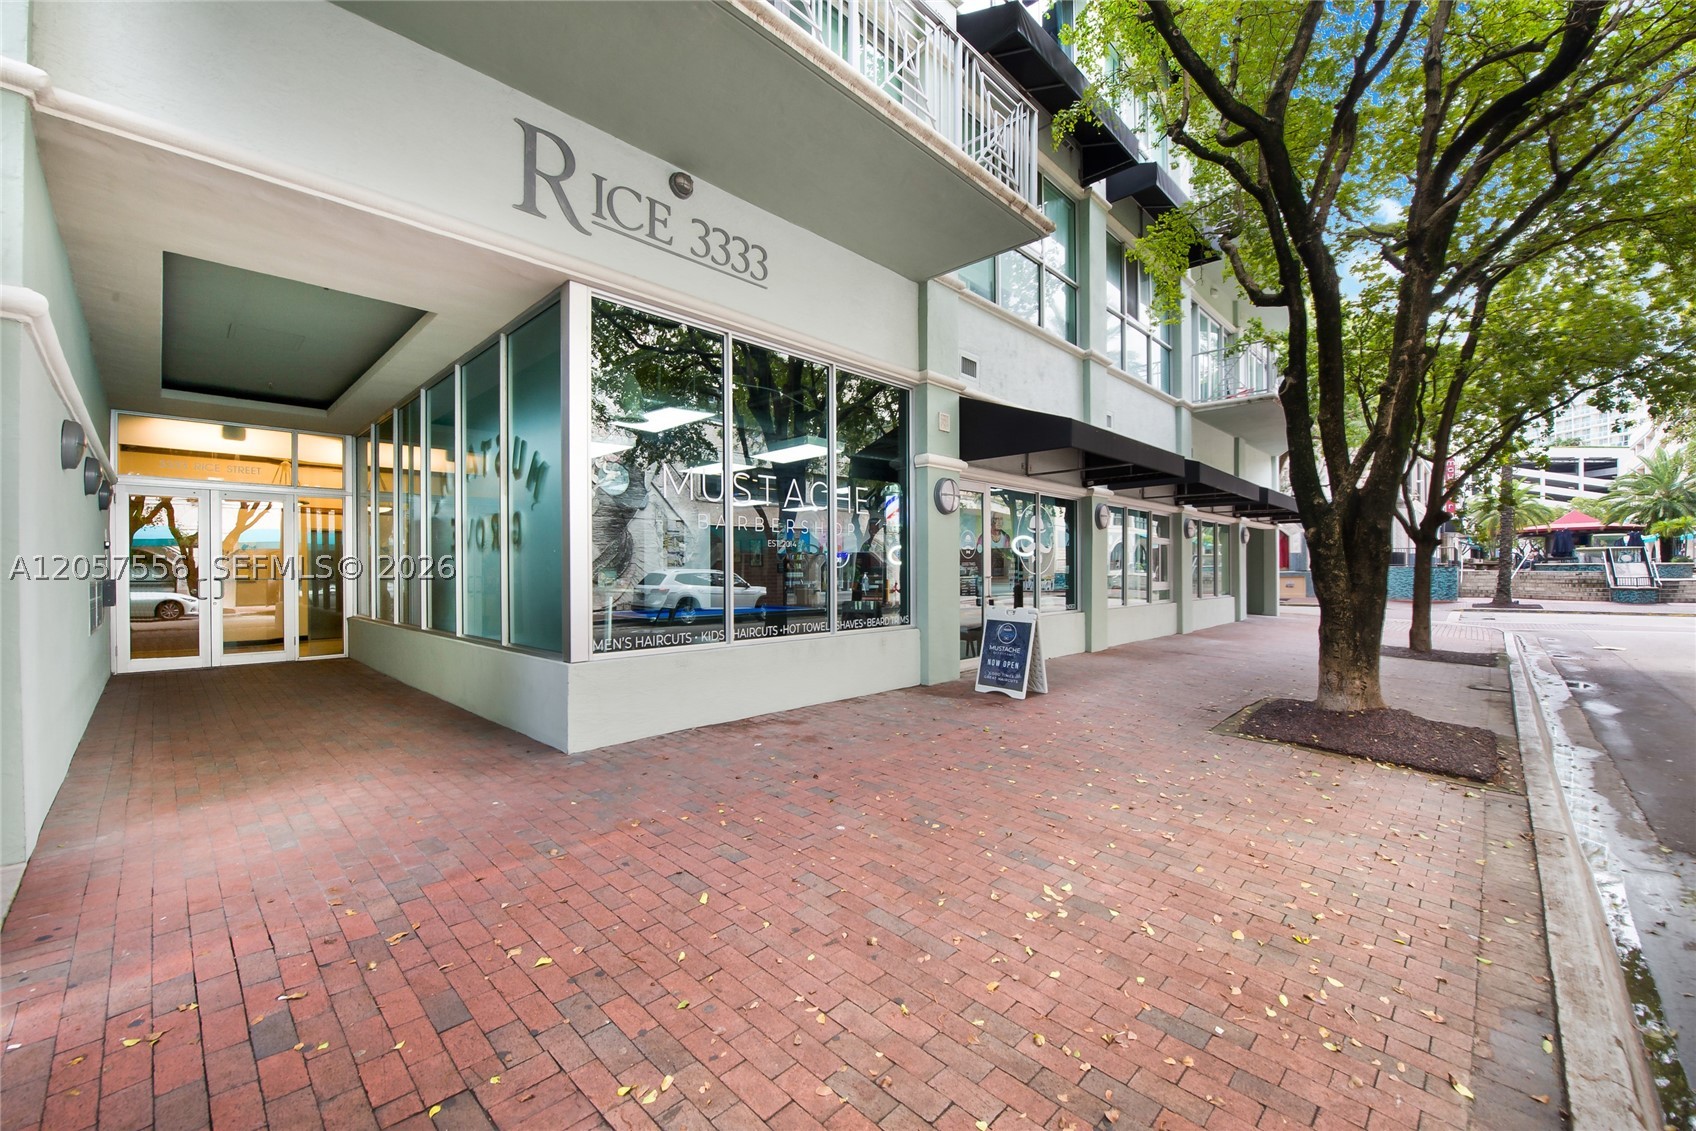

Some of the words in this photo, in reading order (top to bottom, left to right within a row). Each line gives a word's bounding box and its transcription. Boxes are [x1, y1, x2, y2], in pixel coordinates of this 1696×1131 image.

[512, 117, 673, 246] RICE
[690, 218, 768, 281] 3333
[194, 462, 220, 472] RICE
[227, 465, 262, 475] STREET
[662, 463, 870, 515] MUSTACHE
[698, 513, 855, 537] BARBERSHOP
[592, 637, 632, 652] MEN'S
[635, 632, 692, 648] HAIRCUTS
[701, 630, 725, 641] KIDS
[733, 625, 779, 639] HAIRCUTS
[783, 623, 800, 634] HOT
[802, 621, 830, 632] TOWEL
[835, 619, 864, 631] SHAVES
[867, 617, 889, 627] BEARD
[989, 645, 1021, 654] MUSTACHE
[987, 658, 1001, 667] NOW
[1002, 660, 1020, 669] OPEN
